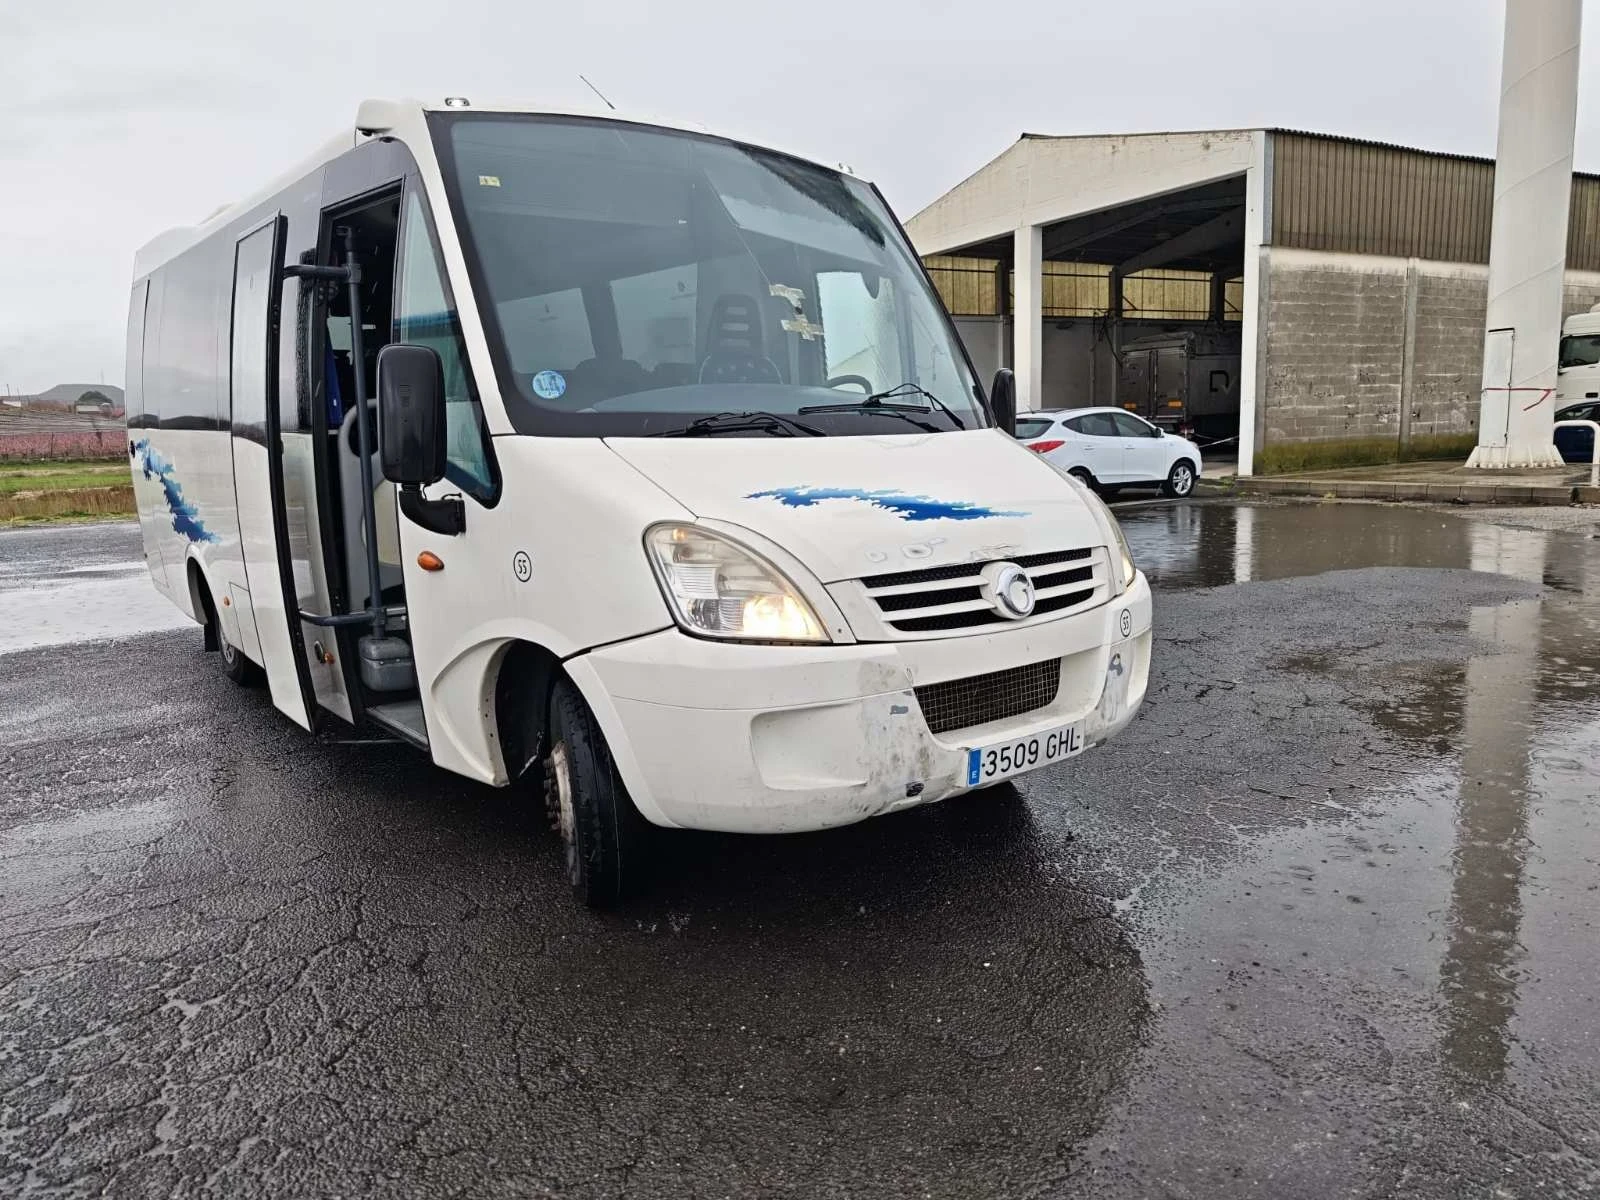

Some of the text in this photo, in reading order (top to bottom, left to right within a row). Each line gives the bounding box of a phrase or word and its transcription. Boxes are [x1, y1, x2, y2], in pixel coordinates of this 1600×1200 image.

[518, 559, 527, 575] 55
[985, 727, 1079, 776] 3509 GHL
